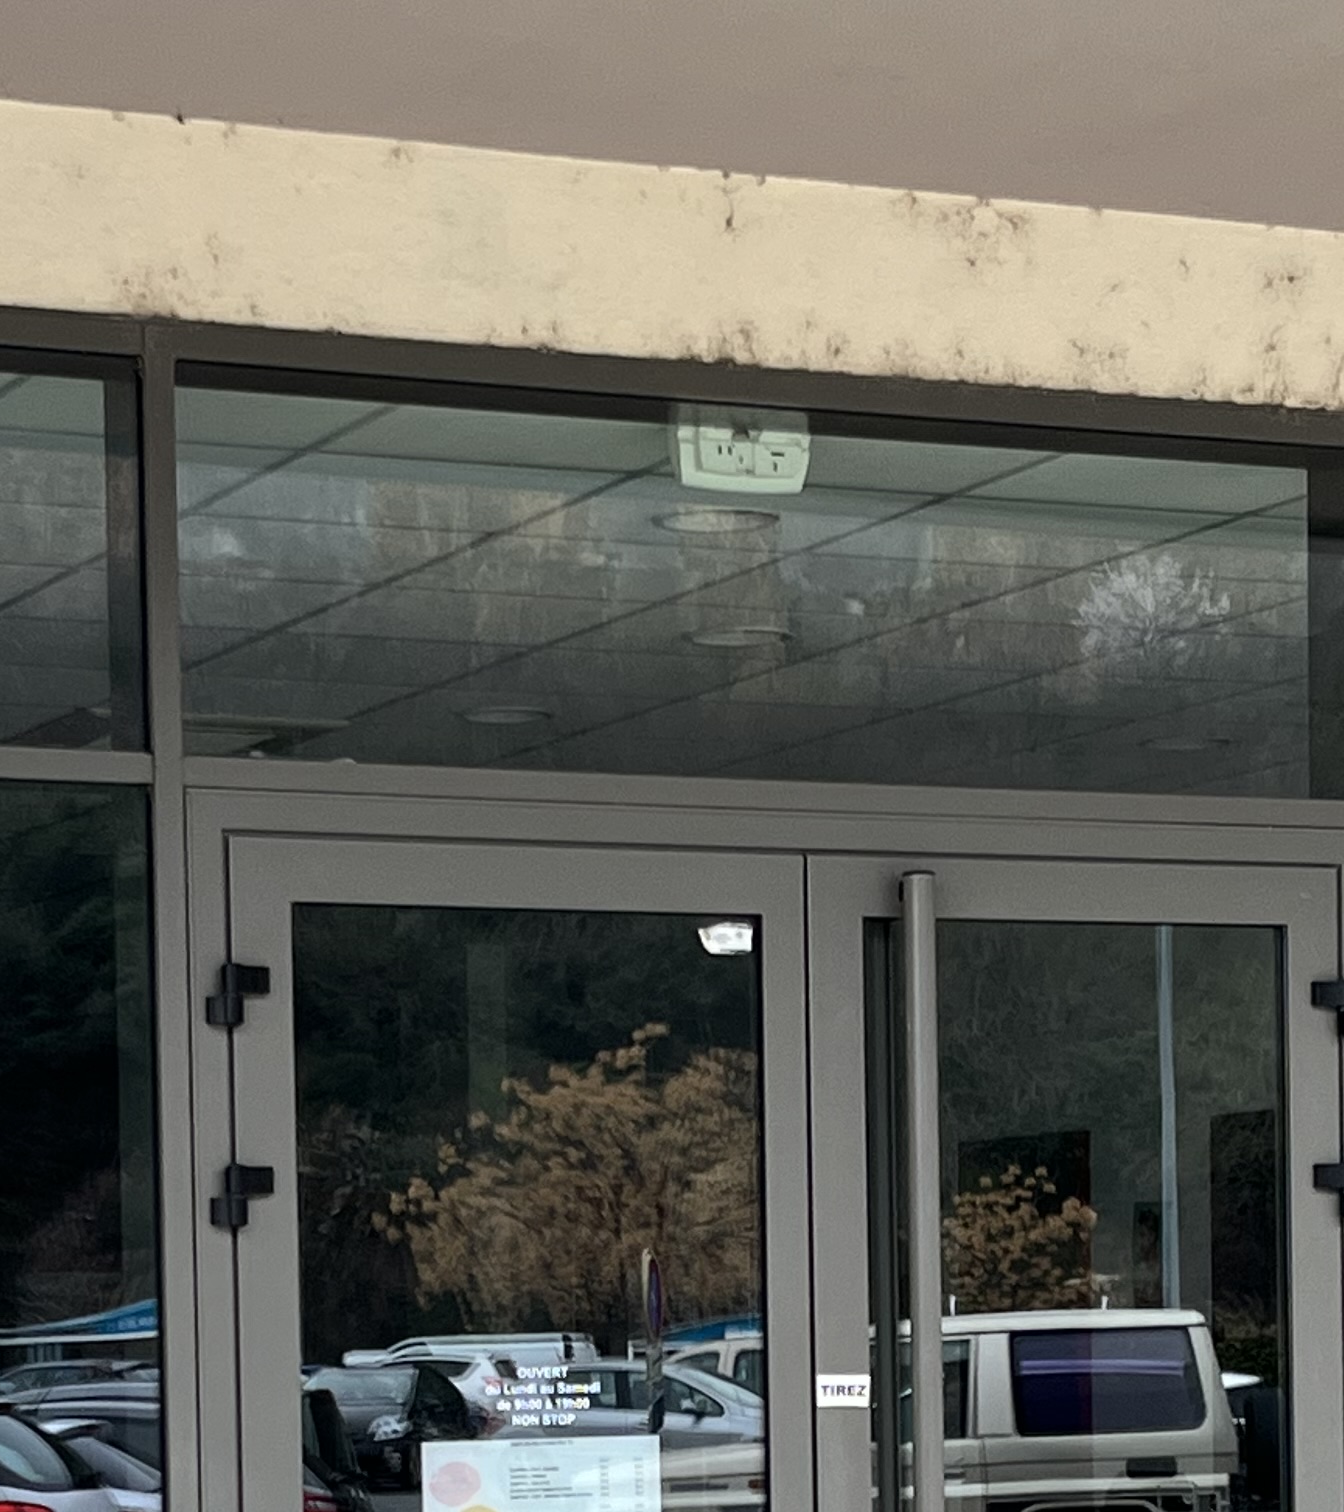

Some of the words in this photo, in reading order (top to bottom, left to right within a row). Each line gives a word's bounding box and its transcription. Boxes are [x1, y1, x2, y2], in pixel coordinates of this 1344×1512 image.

[517, 1366, 568, 1378] OUVERT
[485, 1383, 500, 1395] du
[503, 1382, 537, 1396] Lundi
[557, 1381, 600, 1394] Samedi
[821, 1384, 867, 1397] TIREZ
[511, 1414, 540, 1427] NON
[542, 1413, 576, 1427] STOP
